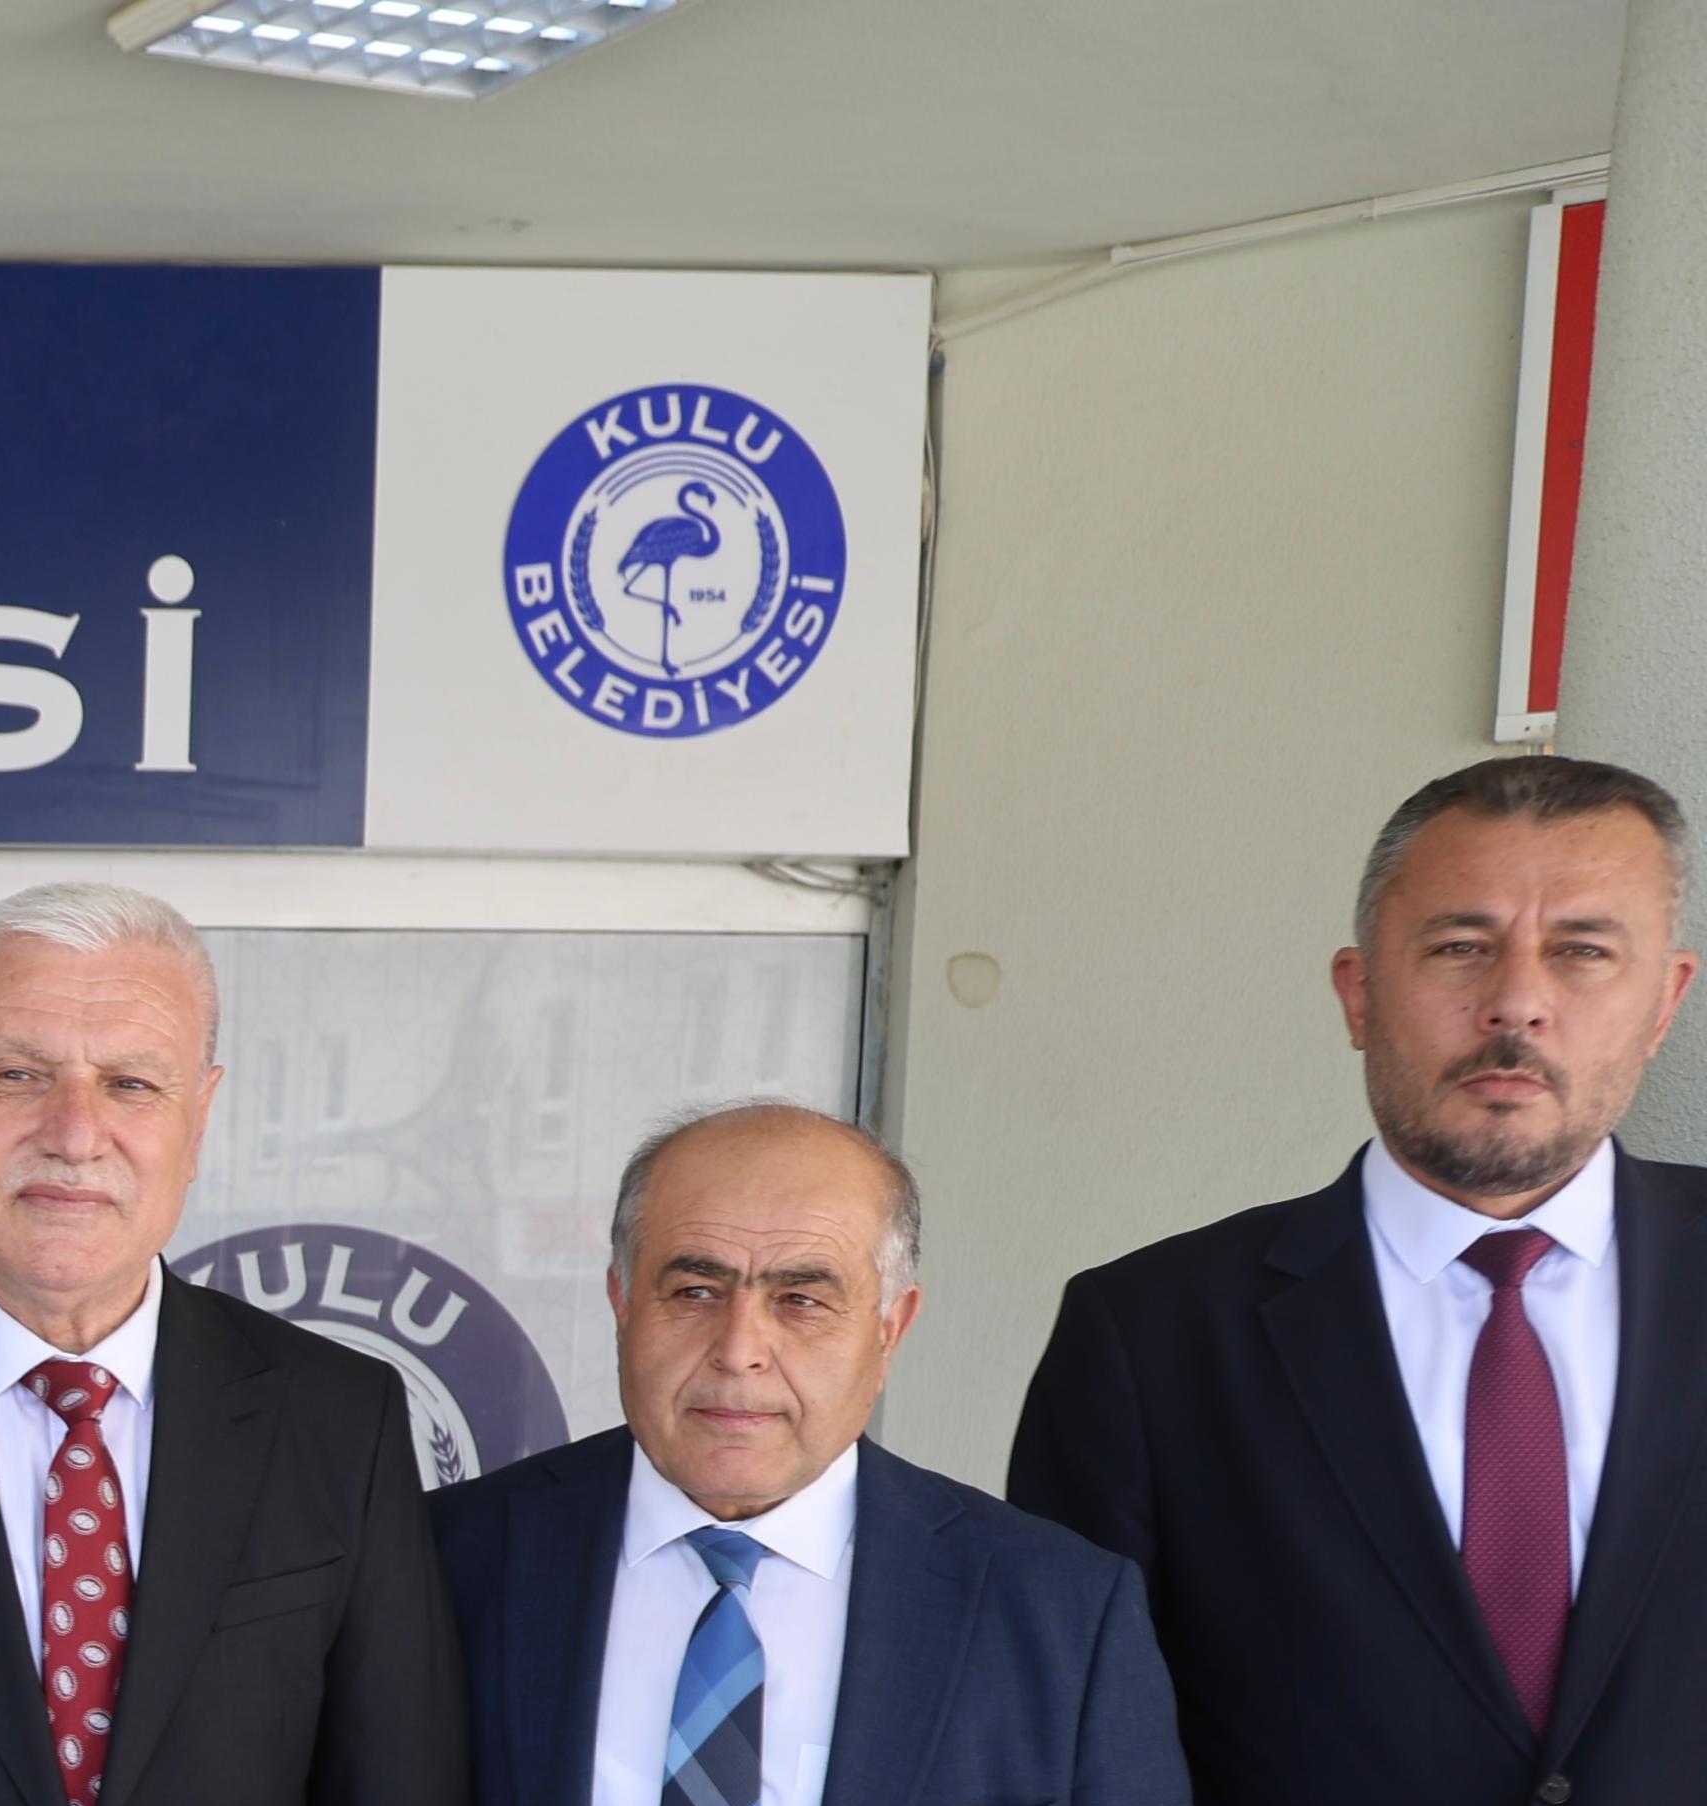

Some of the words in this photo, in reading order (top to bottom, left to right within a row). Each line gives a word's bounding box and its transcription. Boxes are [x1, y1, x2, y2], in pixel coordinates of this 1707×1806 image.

[585, 392, 783, 464] KULU
[689, 588, 727, 602] 1954
[514, 562, 835, 730] BELEDİYESİ
